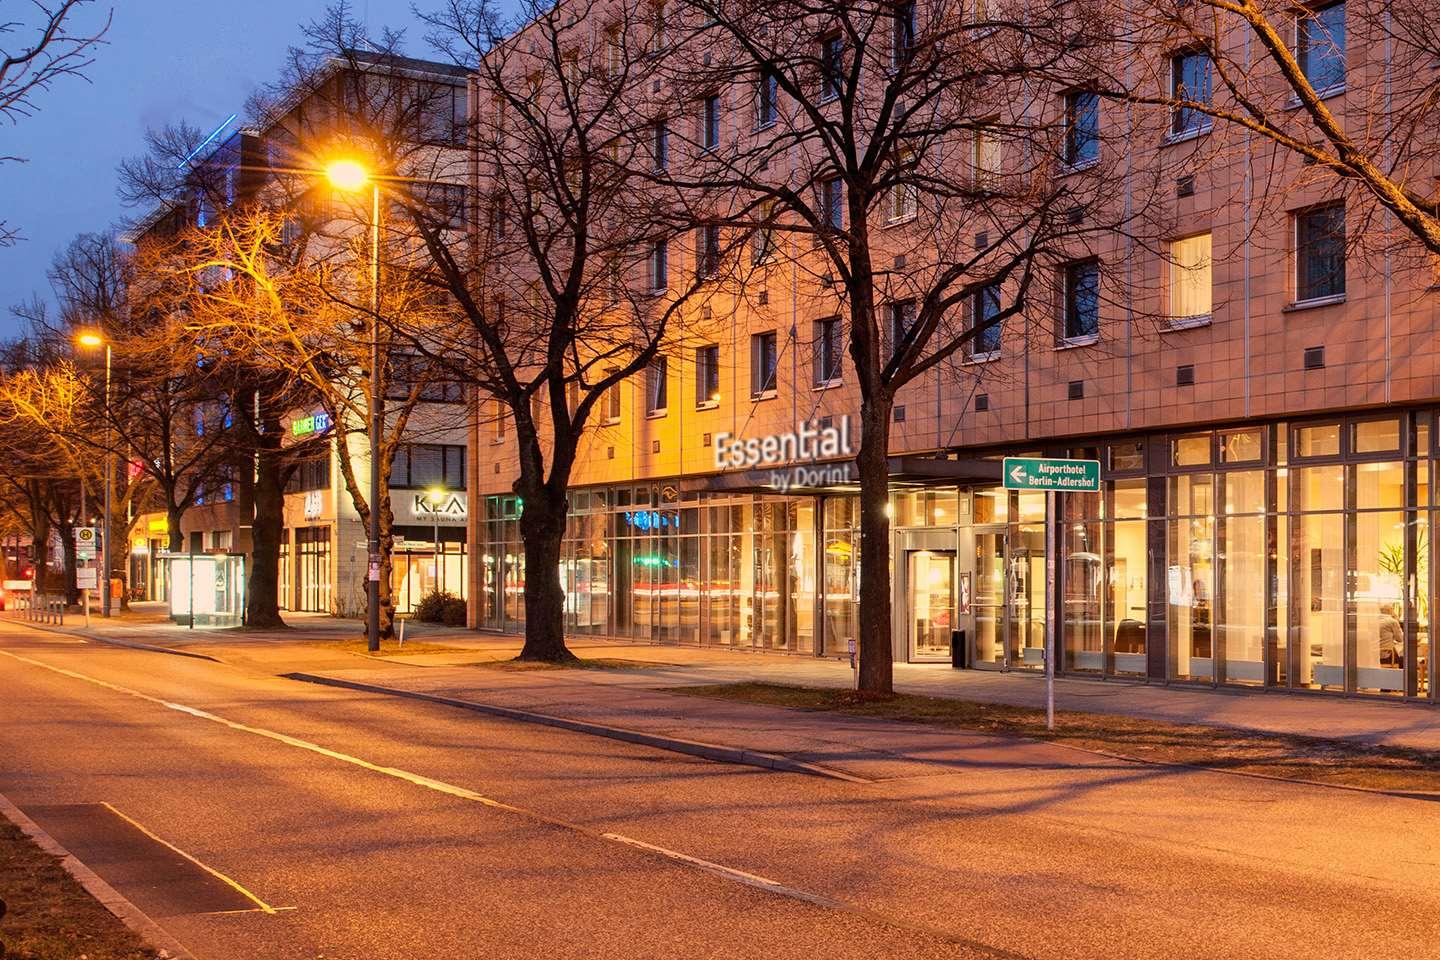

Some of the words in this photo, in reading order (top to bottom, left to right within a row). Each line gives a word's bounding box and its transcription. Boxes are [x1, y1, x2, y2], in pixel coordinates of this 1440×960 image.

[714, 414, 851, 467] Essential
[770, 471, 792, 493] by
[795, 465, 850, 486] Dorint
[1038, 464, 1086, 475] Airporthotel
[1028, 476, 1095, 487] Berlin-Adlershof
